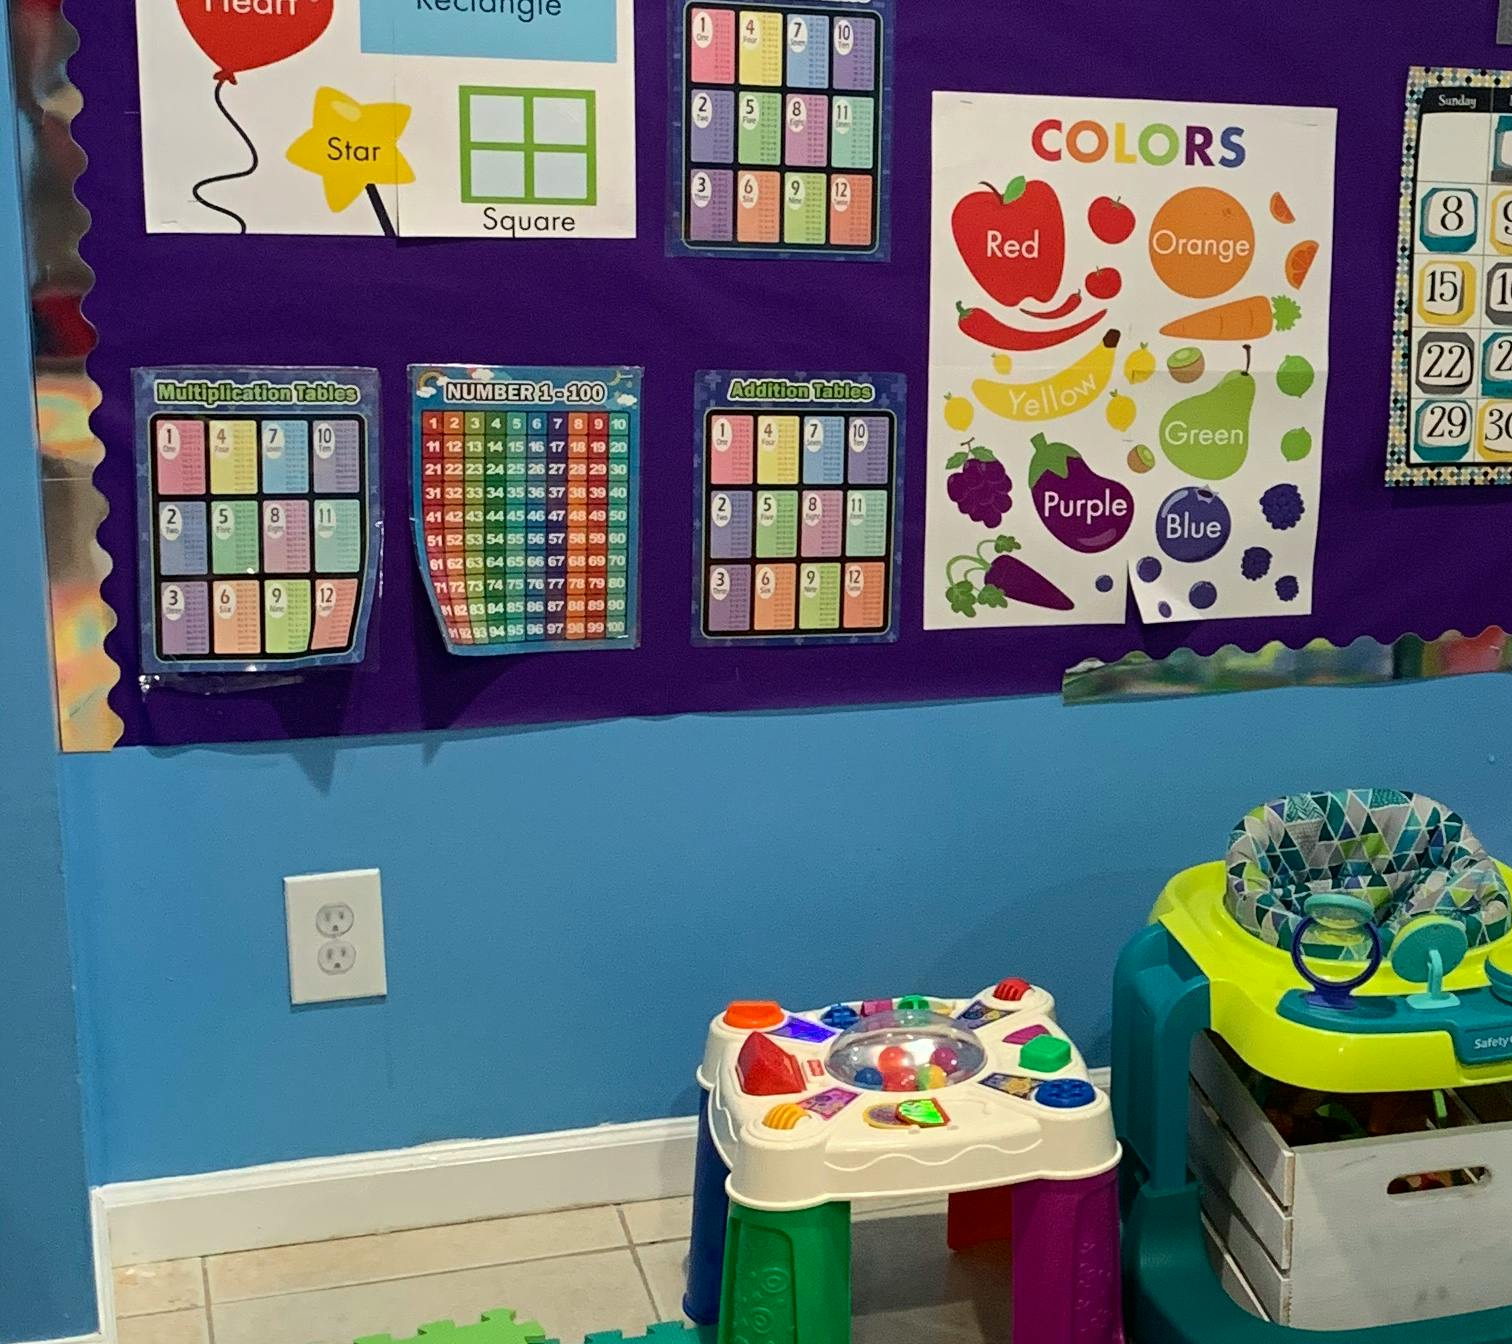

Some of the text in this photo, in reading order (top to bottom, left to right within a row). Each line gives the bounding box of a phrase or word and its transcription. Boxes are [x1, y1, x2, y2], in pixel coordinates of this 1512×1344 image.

[1438, 94, 1477, 110] Sunday
[327, 137, 381, 163] Star
[1031, 119, 1246, 168] COLORS
[483, 208, 575, 238] Square
[986, 229, 1039, 260] Red
[1152, 230, 1250, 264] Orange
[157, 383, 358, 406] Multiplication Tables
[447, 382, 535, 402] NUMBER
[730, 381, 873, 400] Addition Tables
[1009, 372, 1097, 417] Yellow
[1165, 420, 1243, 447] Green
[1043, 492, 1127, 523] Purple
[1166, 514, 1221, 539] Blue
[1474, 1036, 1509, 1049] Safety
